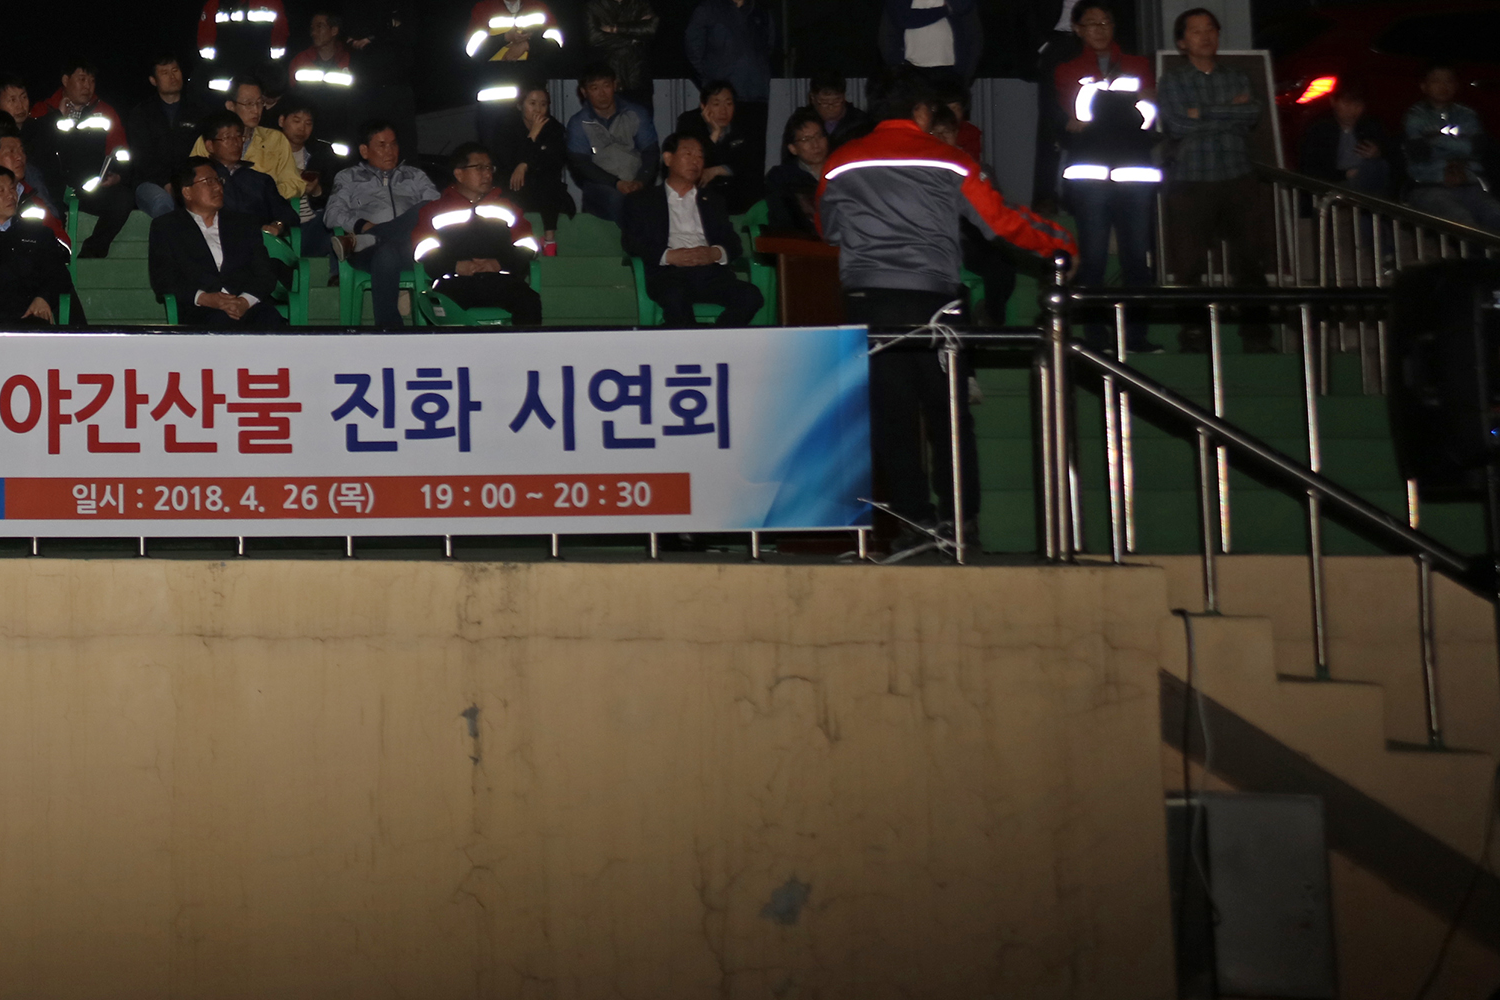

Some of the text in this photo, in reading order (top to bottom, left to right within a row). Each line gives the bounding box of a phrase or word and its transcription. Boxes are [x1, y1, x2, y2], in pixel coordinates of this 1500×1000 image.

[0, 367, 302, 455] 야간산불
[331, 366, 482, 453] 진화
[509, 361, 731, 451] 시연회
[153, 485, 230, 513] 2018.
[239, 485, 265, 513] 4.
[328, 482, 374, 514] (목)
